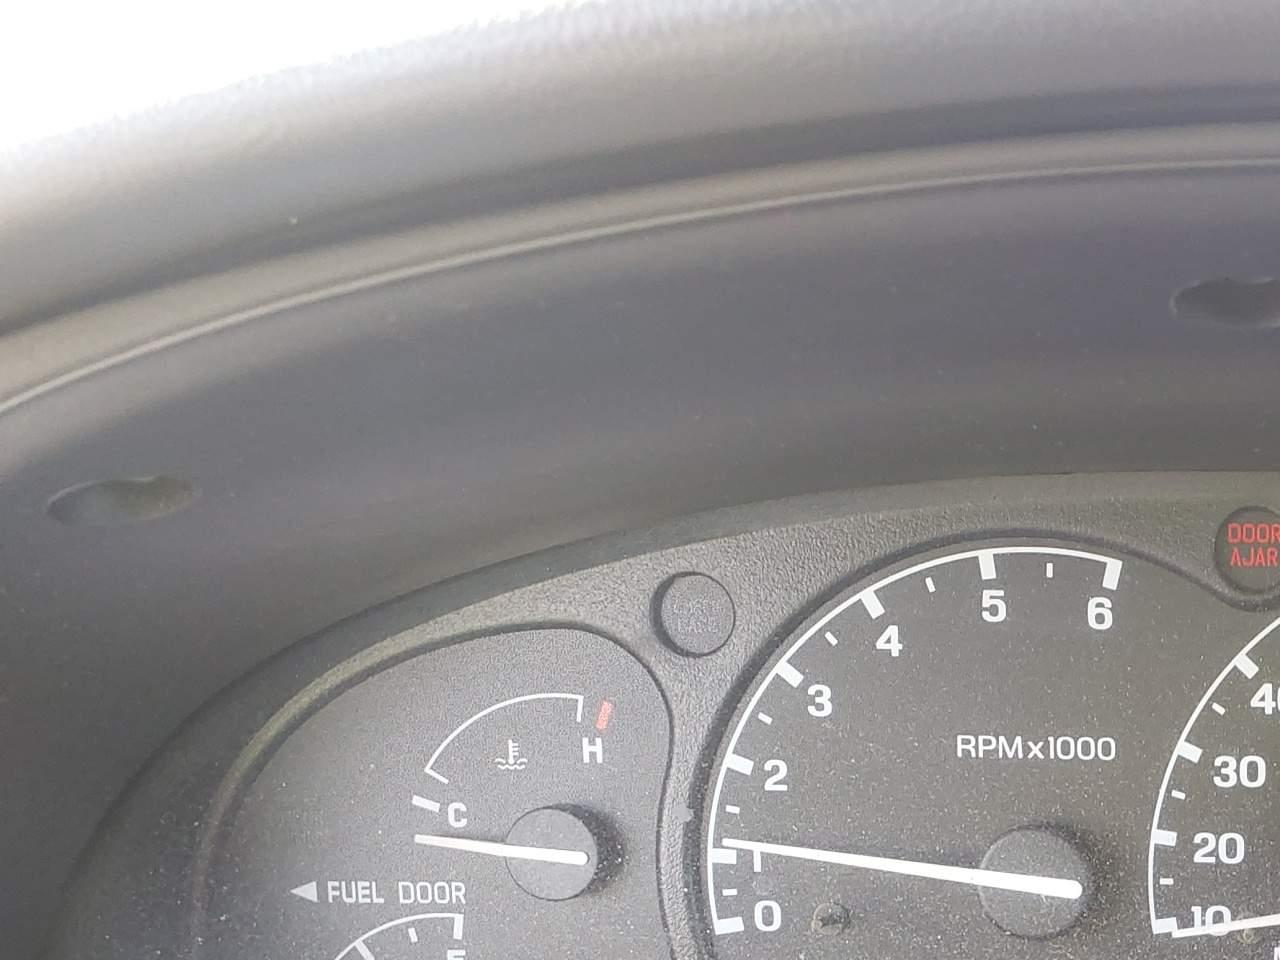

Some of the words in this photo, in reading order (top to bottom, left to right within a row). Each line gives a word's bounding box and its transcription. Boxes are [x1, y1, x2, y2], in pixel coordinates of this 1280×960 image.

[1232, 548, 1277, 565] AJAR
[982, 590, 1006, 622] 5
[1088, 597, 1112, 629] 6
[876, 625, 902, 656] 4
[808, 684, 832, 717] 3
[583, 737, 602, 763] H
[957, 735, 1115, 760] RPMx1000
[764, 760, 787, 791] 2
[1214, 756, 1265, 787] 30
[448, 802, 467, 828] C
[1194, 833, 1244, 864] 20
[328, 881, 384, 903] FUEL
[399, 882, 465, 904] DOOR
[755, 901, 781, 931] 0
[1191, 905, 1231, 936] 10
